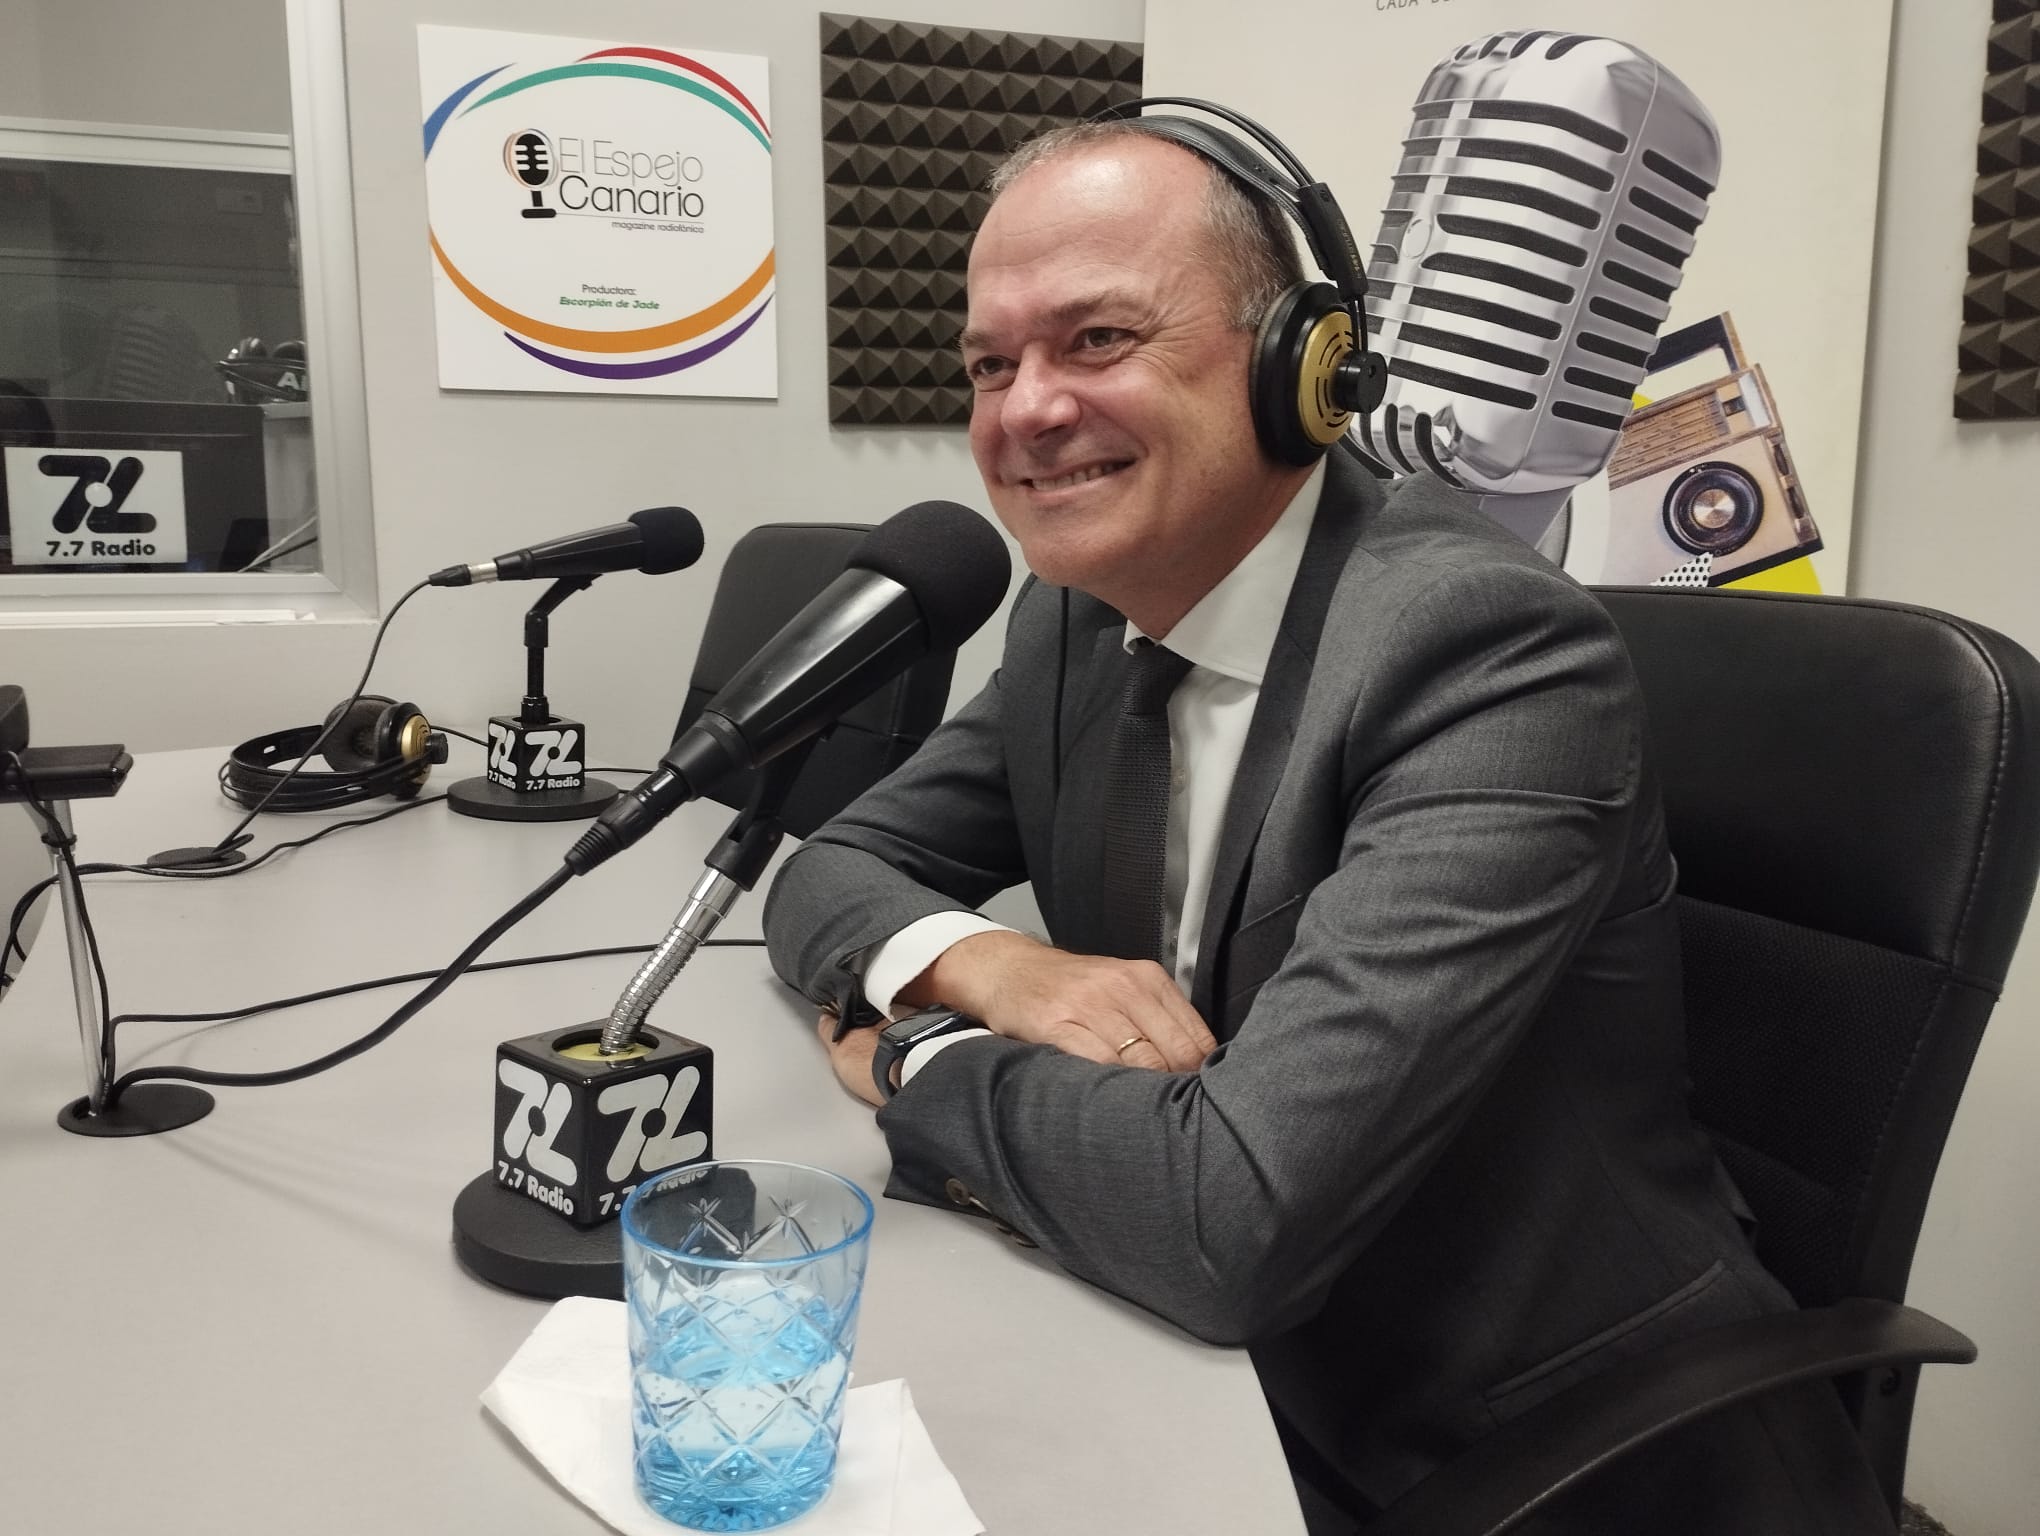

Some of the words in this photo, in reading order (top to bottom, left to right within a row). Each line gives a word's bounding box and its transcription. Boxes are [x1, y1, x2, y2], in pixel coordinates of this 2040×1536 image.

[559, 137, 585, 173] El
[593, 140, 703, 187] Espejo
[559, 175, 704, 218] Canario
[611, 221, 656, 231] magazine
[559, 296, 613, 308] Escorpión
[615, 299, 630, 308] de
[632, 300, 660, 309] Jade
[46, 541, 84, 556] 7.7
[91, 539, 156, 556] Radio
[526, 779, 546, 791] 7.7
[547, 776, 580, 789] Radio
[498, 1160, 525, 1189] 7.7
[527, 1174, 574, 1216] Radio
